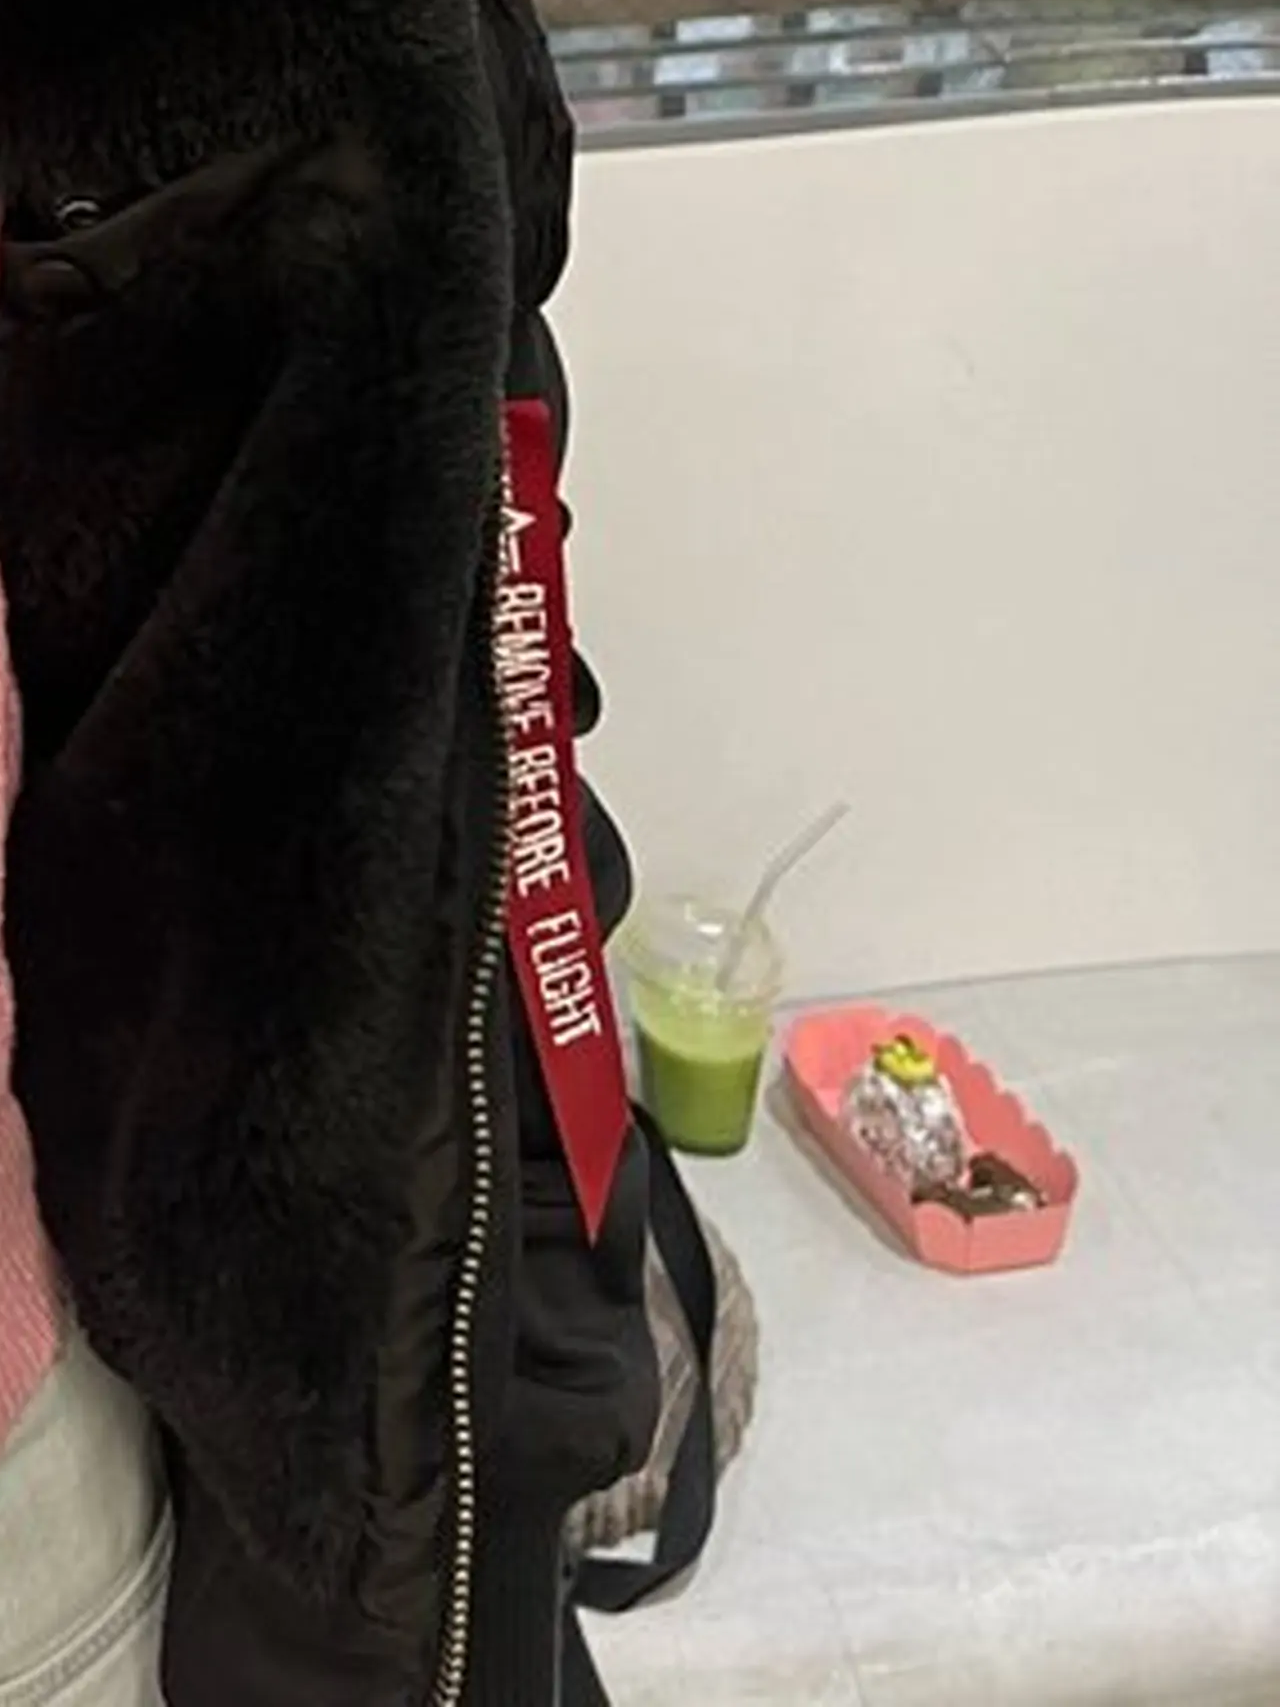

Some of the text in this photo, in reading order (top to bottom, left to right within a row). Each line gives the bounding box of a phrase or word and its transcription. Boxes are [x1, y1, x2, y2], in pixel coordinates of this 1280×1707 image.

[495, 583, 603, 1046] REMOVE BEFORE FLIGHT
